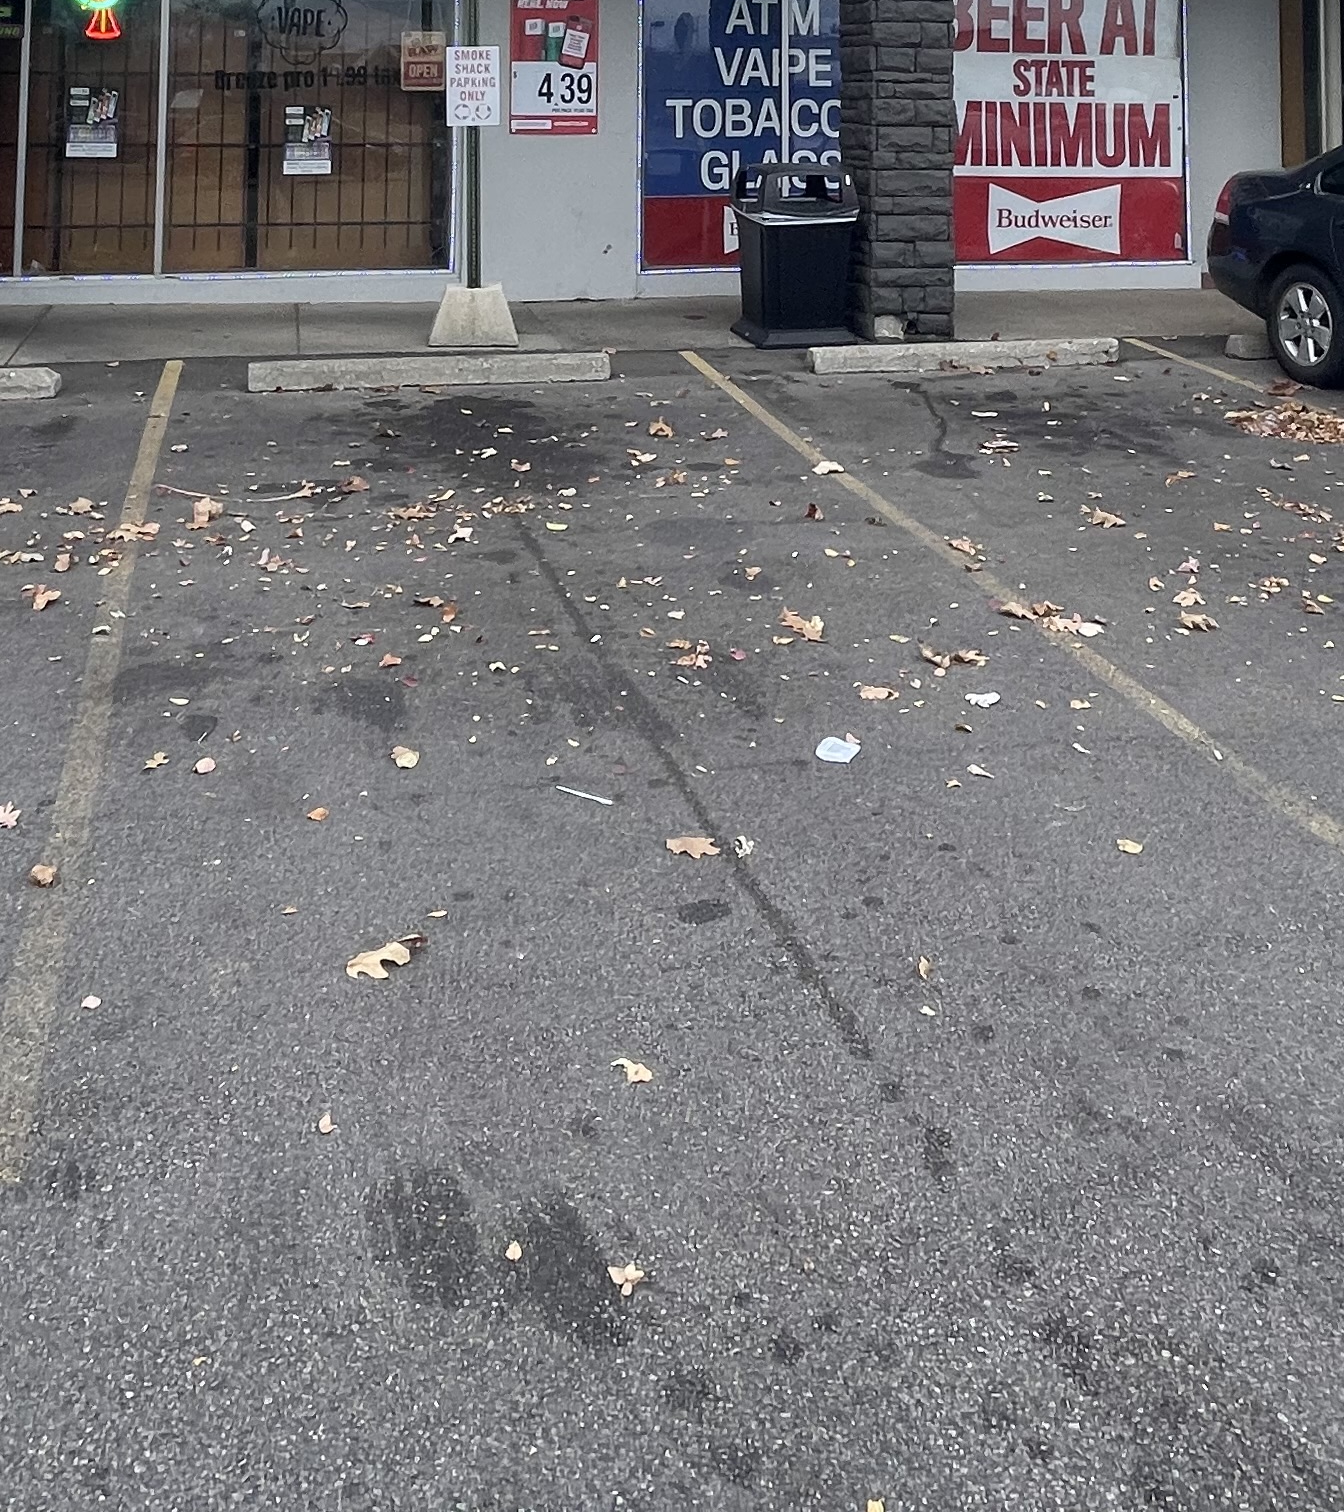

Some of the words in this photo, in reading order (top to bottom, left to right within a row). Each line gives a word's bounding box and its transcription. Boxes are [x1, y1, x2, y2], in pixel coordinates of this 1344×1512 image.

[276, 6, 327, 37] VAPE
[455, 50, 491, 61] SMOKE
[455, 63, 491, 74] SHACK
[714, 47, 832, 87] VAPE
[409, 64, 439, 78] OPEN
[450, 77, 496, 88] PARKING
[1013, 59, 1095, 97] STATE
[460, 91, 486, 102] ONLY
[538, 73, 593, 105] 4.39
[666, 99, 842, 138] TOBACC
[953, 101, 1172, 168] MINIMUM
[996, 208, 1113, 229] Budweiser
